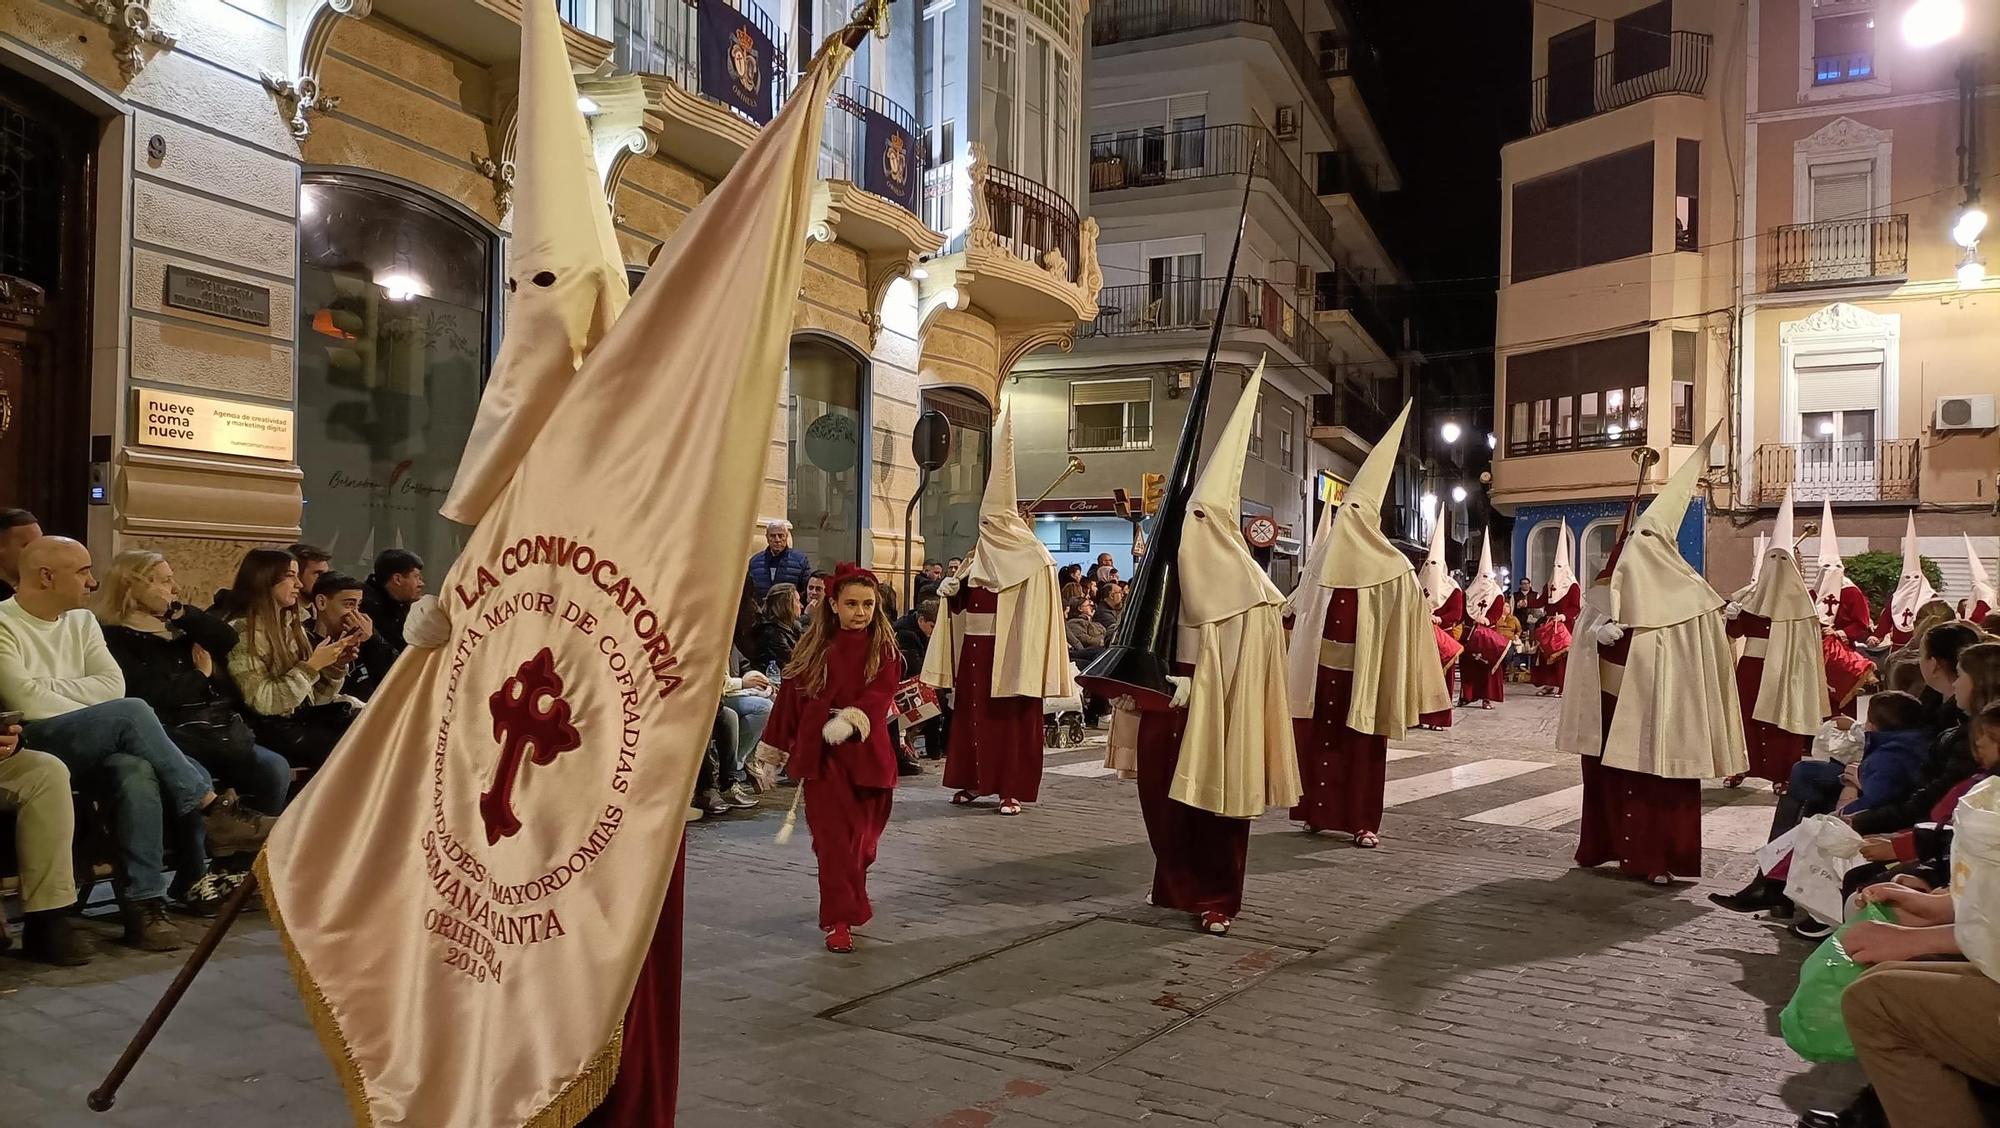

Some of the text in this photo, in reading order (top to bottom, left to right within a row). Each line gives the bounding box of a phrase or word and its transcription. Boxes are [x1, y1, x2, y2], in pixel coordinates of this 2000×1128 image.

[148, 134, 167, 160] 9
[149, 400, 195, 416] nueve
[213, 409, 241, 420] Agencia
[251, 415, 287, 426] creatividad
[149, 414, 189, 427] coma
[231, 420, 266, 431] marketing
[266, 424, 287, 433] digital
[149, 425, 194, 439] nueve
[1069, 500, 1099, 511] Bar
[455, 535, 684, 699] LA CONVOCATORIA
[483, 592, 555, 631] MAYOR
[561, 600, 598, 635] DE
[599, 635, 641, 794] COFRADIAS
[491, 804, 624, 905] MAYORDOMIAS
[490, 909, 566, 945] SANTA
[443, 947, 486, 983] 2019
